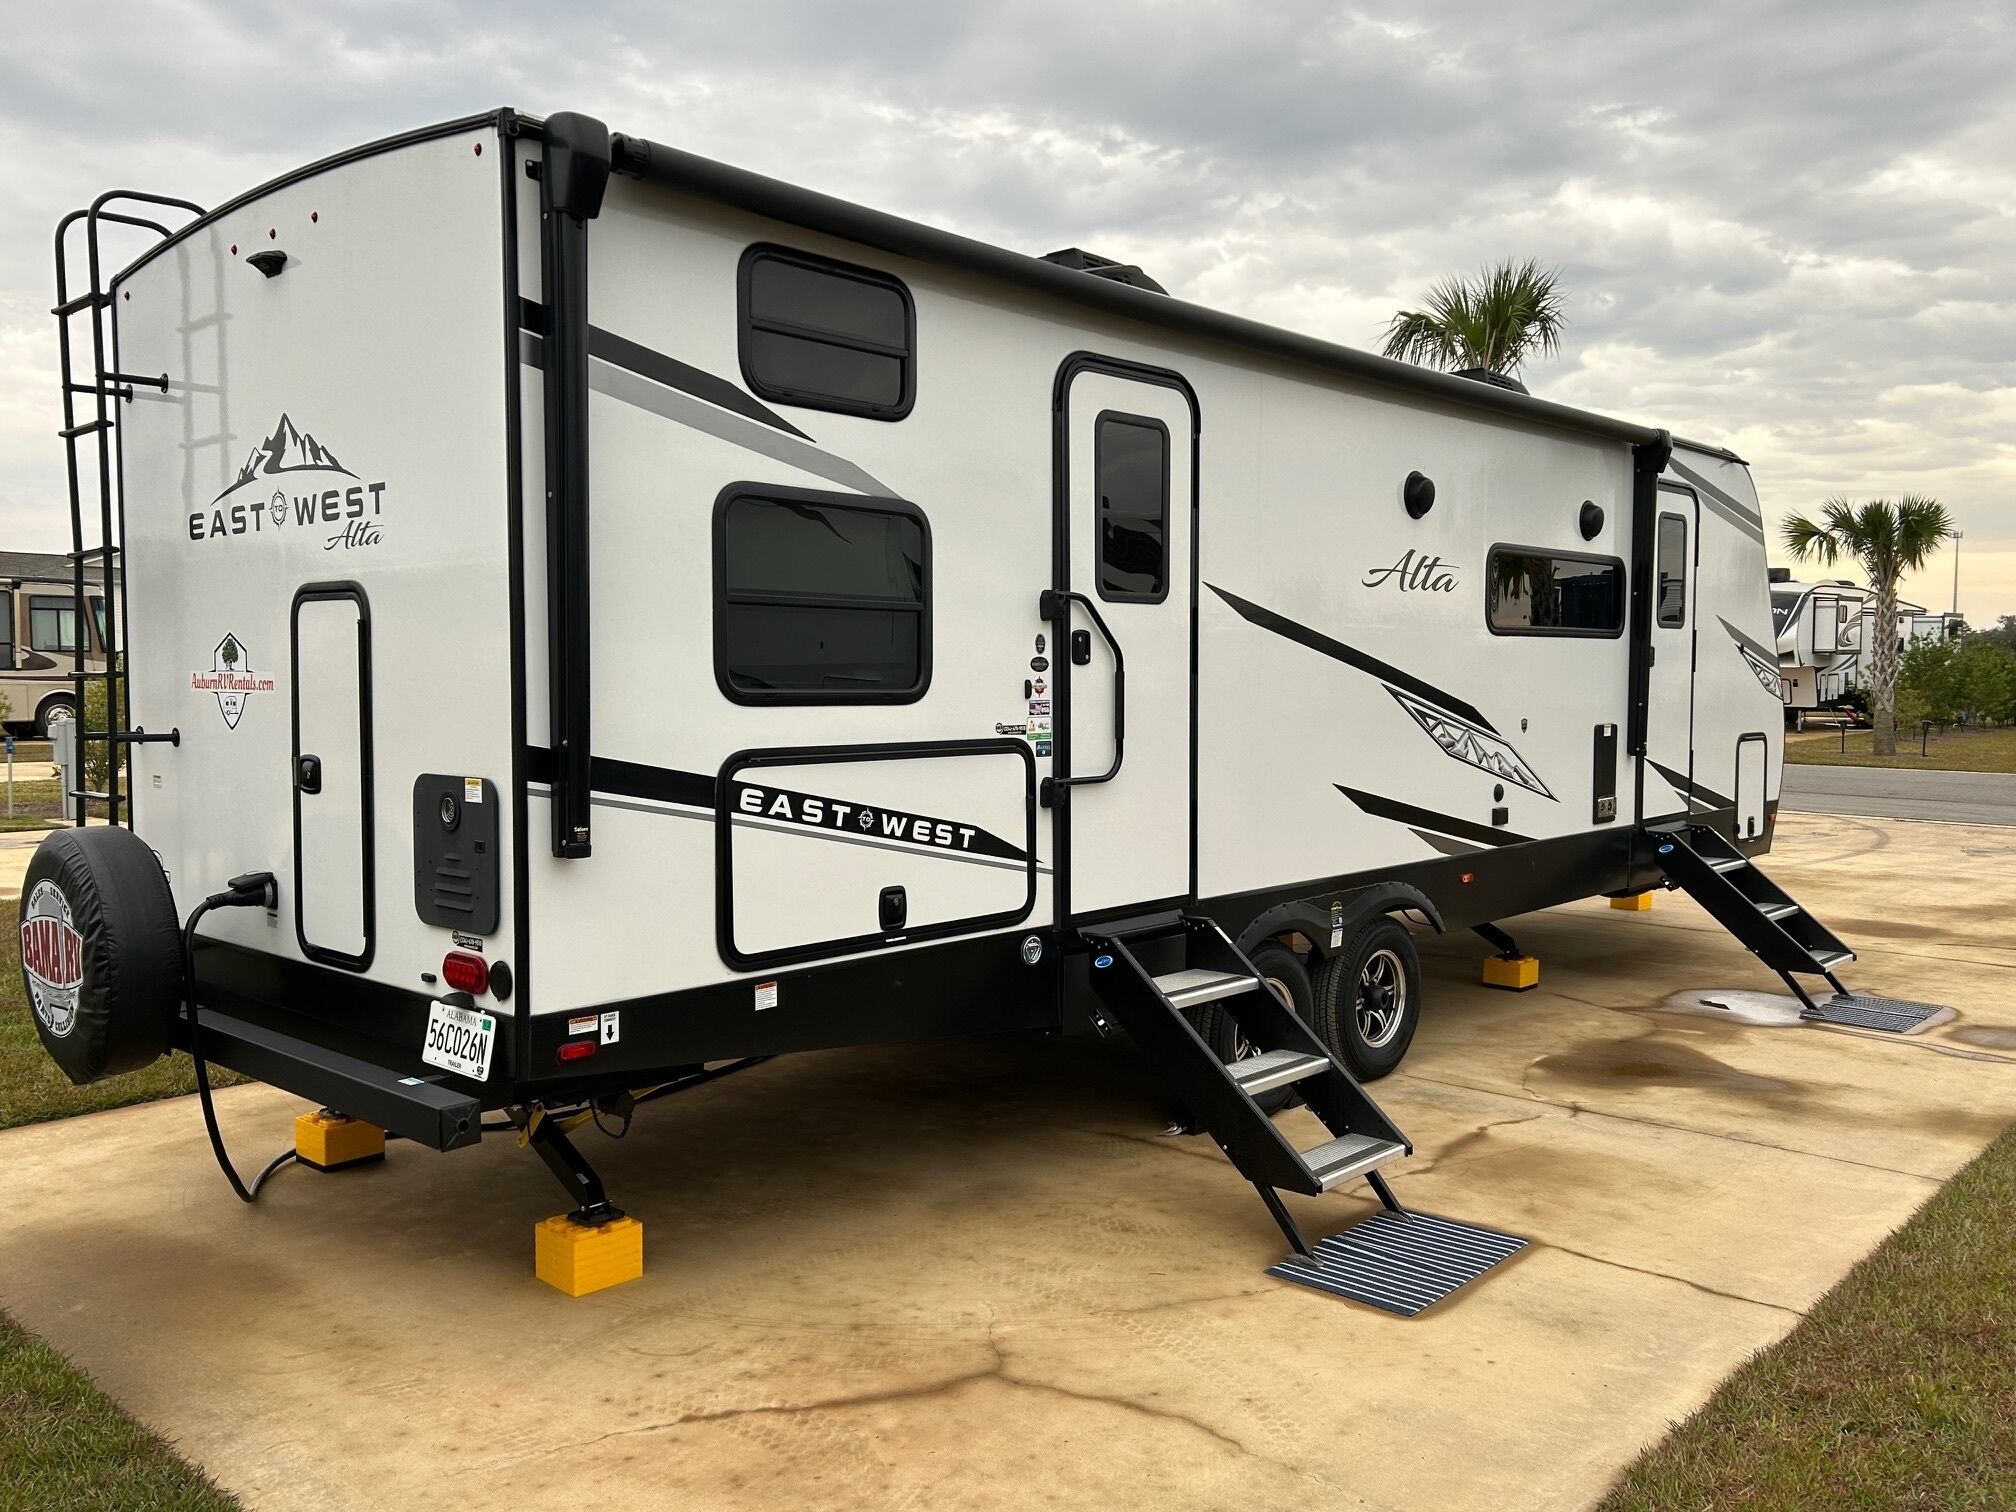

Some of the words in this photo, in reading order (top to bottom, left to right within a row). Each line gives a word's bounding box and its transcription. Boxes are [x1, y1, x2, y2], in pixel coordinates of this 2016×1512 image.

[189, 502, 265, 541] EAST
[274, 504, 283, 512] TO
[293, 482, 386, 526] WEST
[323, 520, 385, 551] Alta
[1361, 548, 1460, 593] Alta
[191, 672, 274, 691] AuburnRVRentals.com
[739, 788, 851, 828] EAST
[881, 812, 976, 849] WEST
[31, 886, 44, 910] SALES
[49, 886, 70, 918] SERVICE
[22, 919, 63, 984] BAMA
[63, 925, 82, 984] RV
[34, 991, 51, 1025] PARTS
[446, 1009, 477, 1026] ALABAMA
[428, 1018, 488, 1065] 56C026N
[447, 1059, 462, 1069] TRAILER
